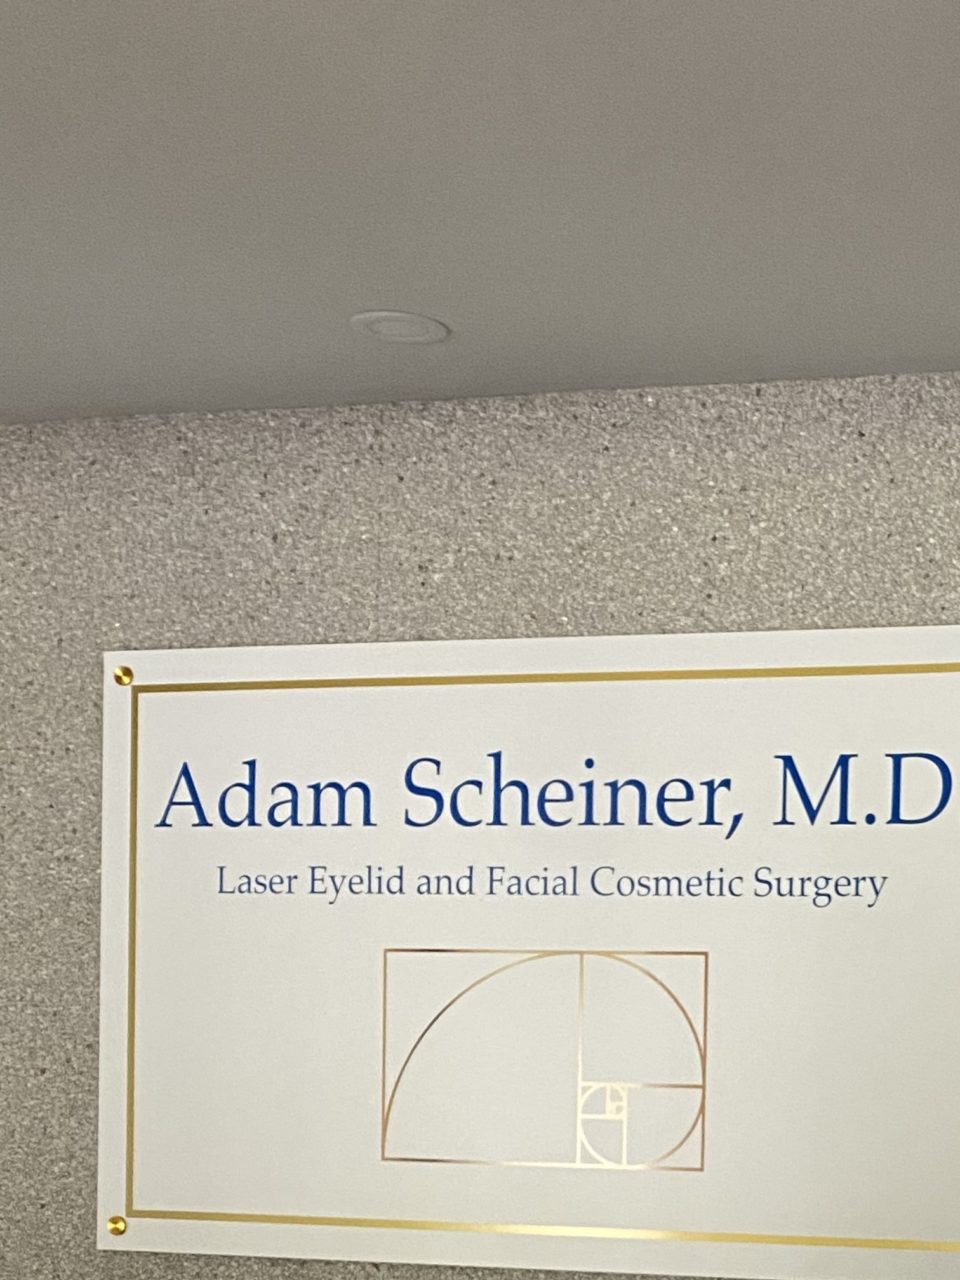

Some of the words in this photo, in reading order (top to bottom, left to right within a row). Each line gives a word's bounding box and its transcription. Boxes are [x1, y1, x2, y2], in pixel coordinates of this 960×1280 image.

[154, 758, 377, 828] Adam
[404, 750, 744, 840] Scheiner,
[216, 865, 298, 895] Laser
[308, 865, 404, 905] Eyelid
[416, 866, 475, 896] and
[485, 865, 580, 896] Facial
[590, 866, 744, 897] Cosmetic
[753, 866, 889, 908] Surgery
